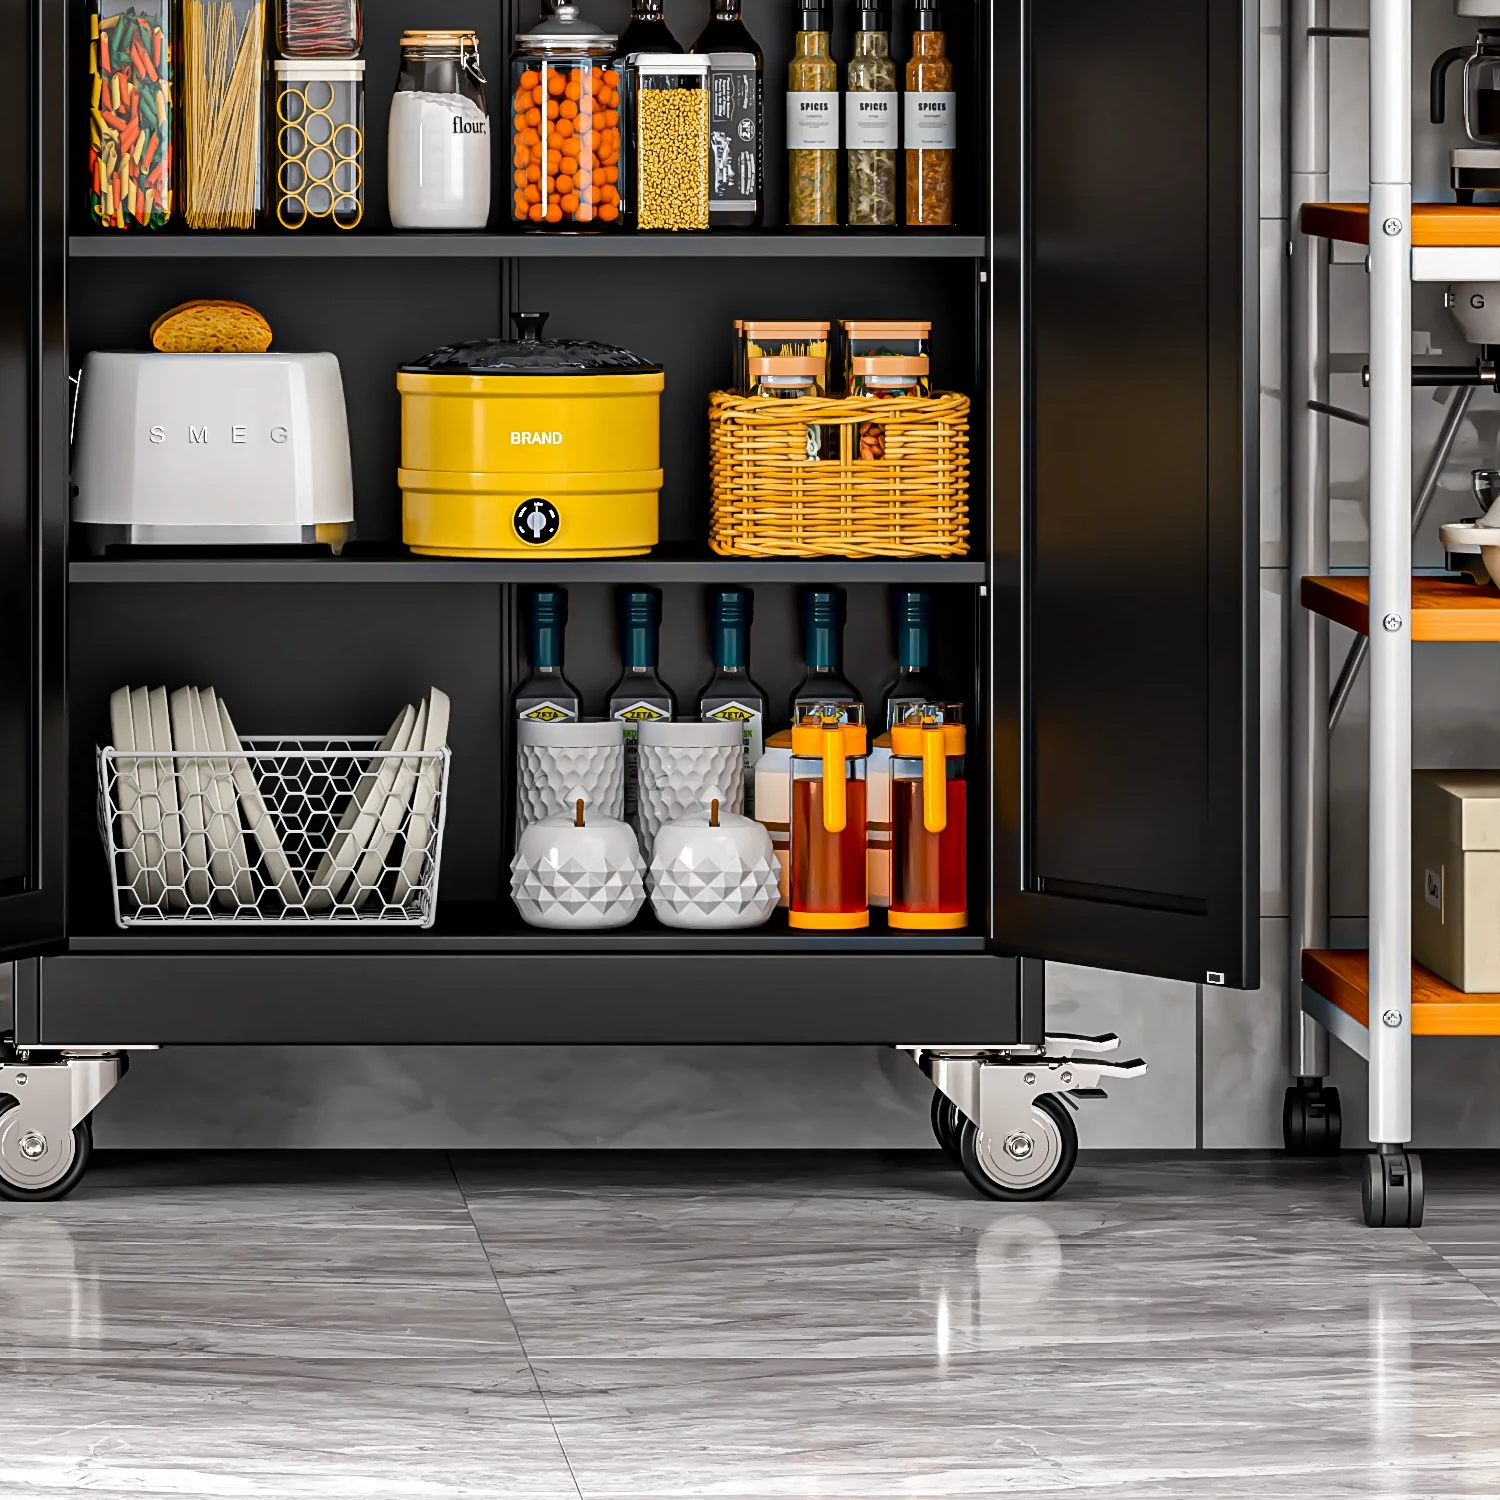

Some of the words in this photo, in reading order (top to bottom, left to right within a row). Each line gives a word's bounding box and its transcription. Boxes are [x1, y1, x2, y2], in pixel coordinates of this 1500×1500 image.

[800, 102, 829, 111] SPICES
[859, 102, 888, 111] SPICES
[918, 102, 947, 111] SPICES
[149, 425, 288, 444] SMEG
[510, 431, 563, 445] BRAND
[630, 711, 654, 719] ZETA
[722, 711, 745, 719] ZETA
